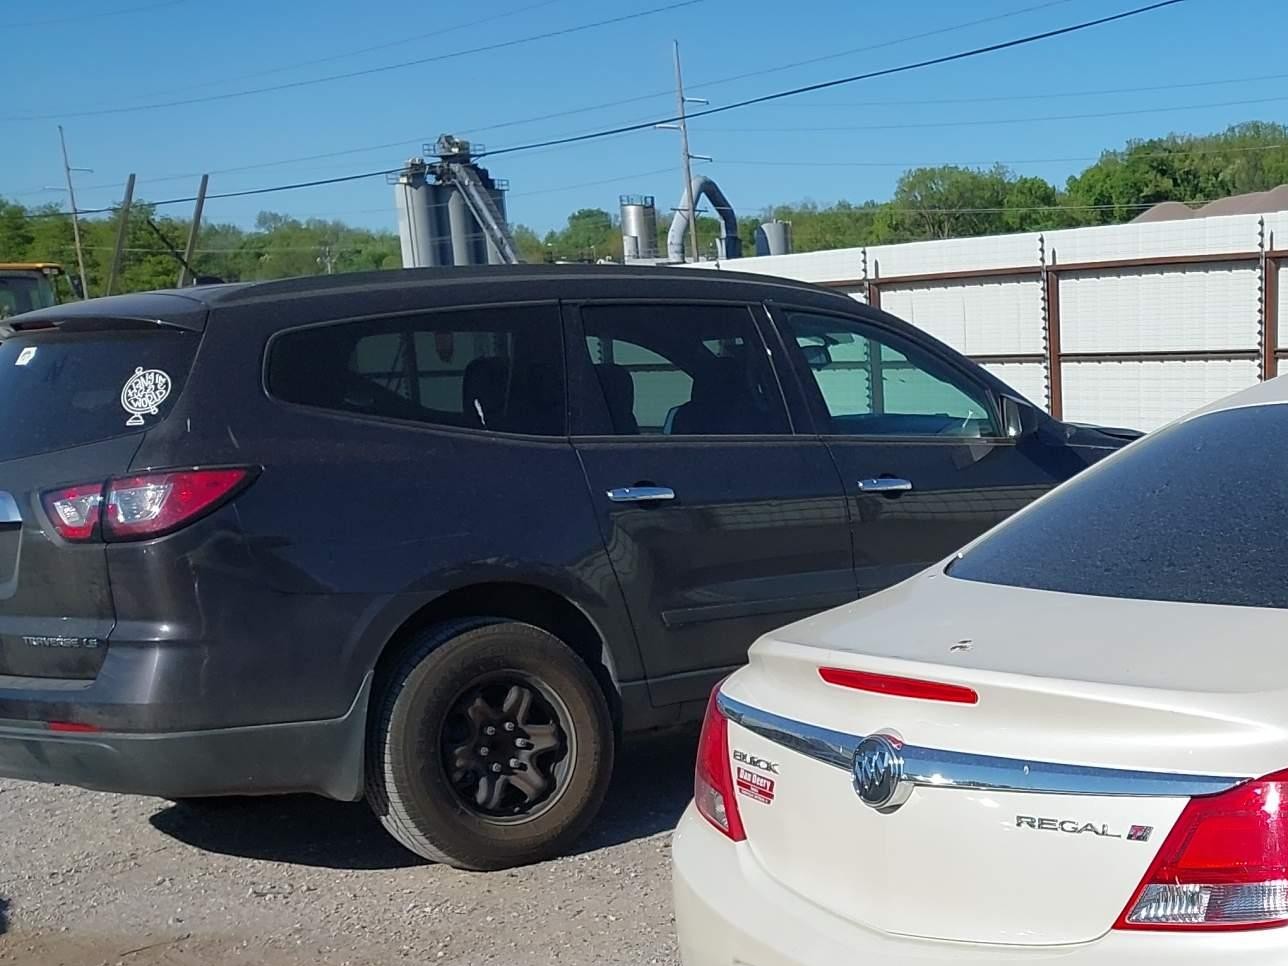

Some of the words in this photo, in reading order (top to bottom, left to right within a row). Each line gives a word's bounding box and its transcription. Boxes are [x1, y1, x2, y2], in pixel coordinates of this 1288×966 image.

[130, 389, 166, 408] WORLD
[733, 750, 780, 775] BUICK
[1016, 815, 1121, 838] REGAL
